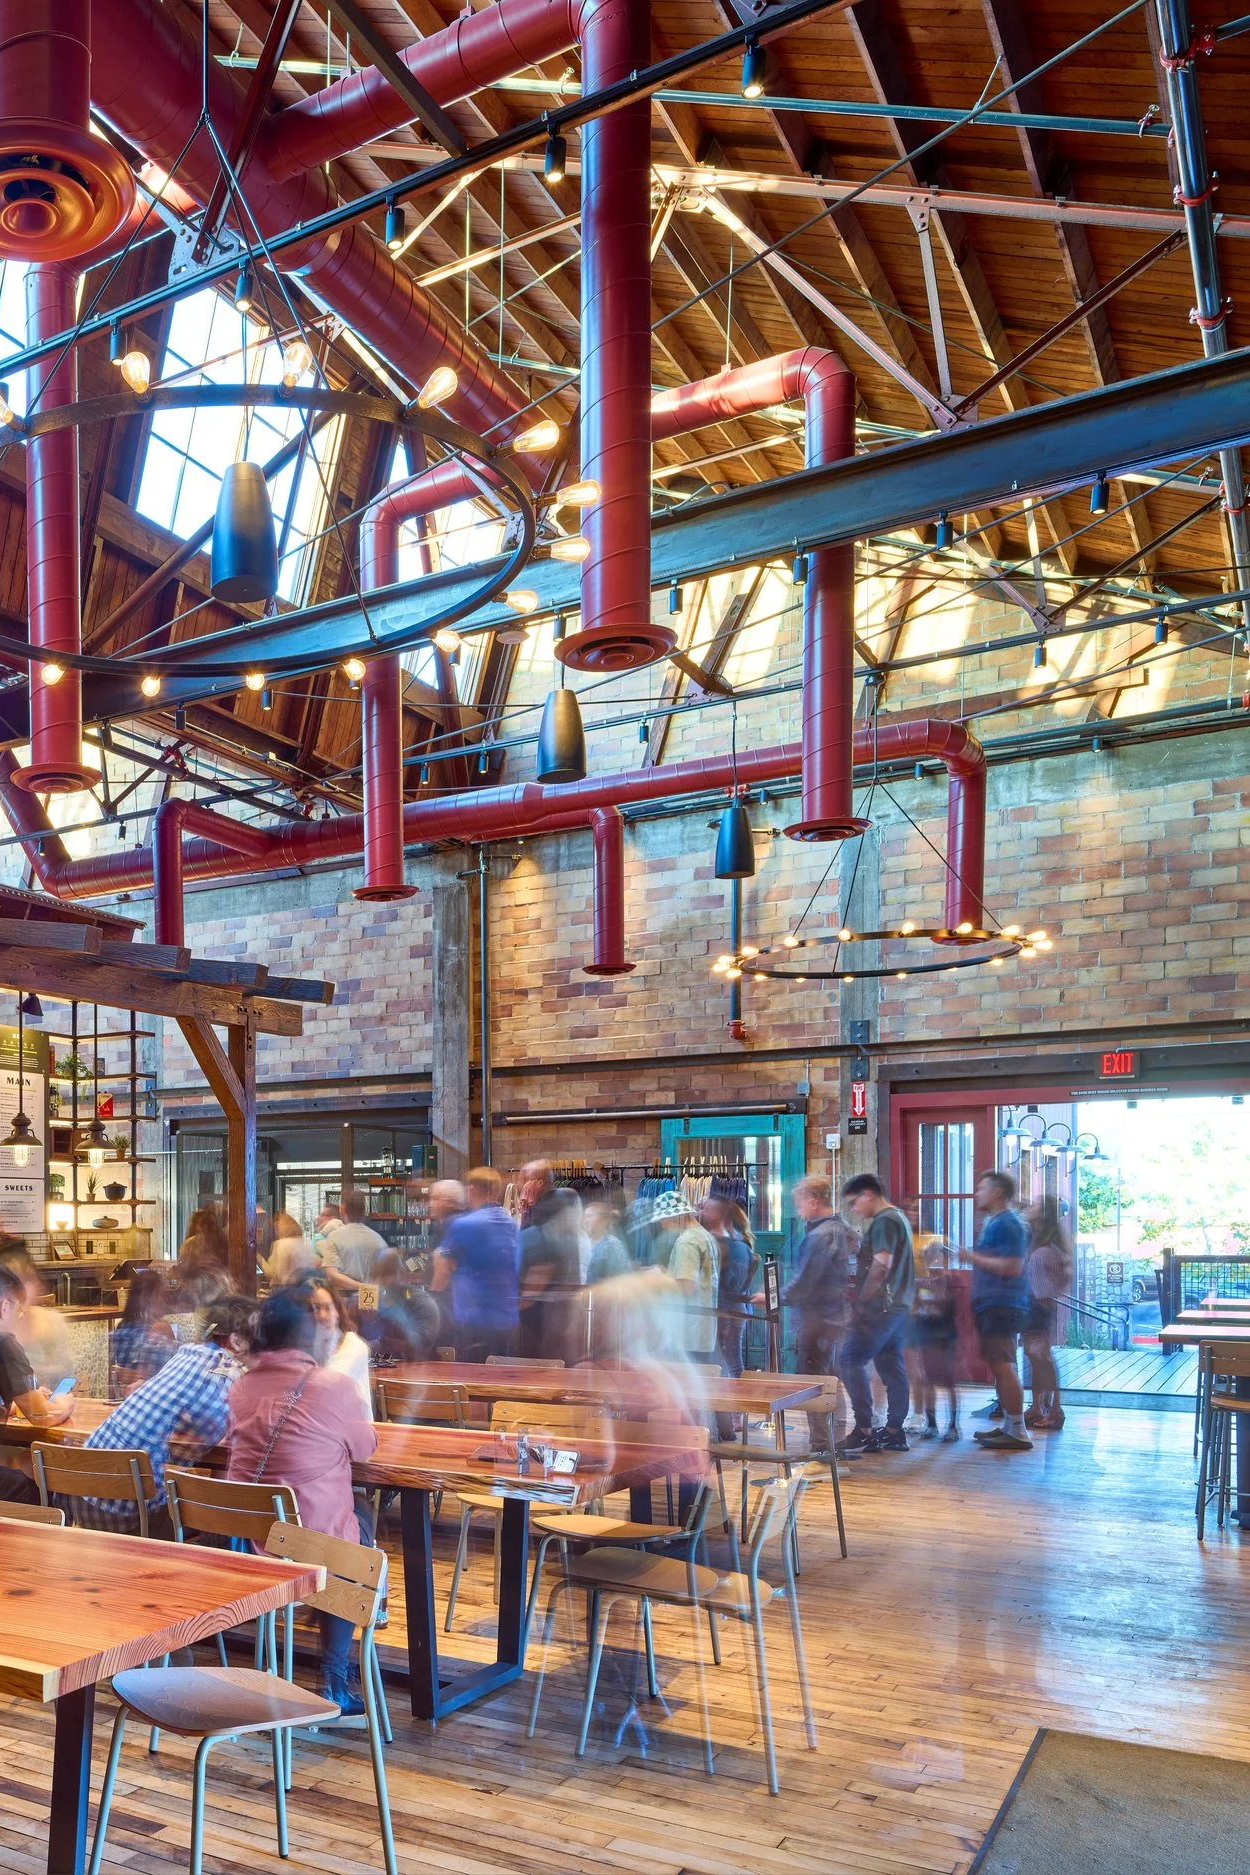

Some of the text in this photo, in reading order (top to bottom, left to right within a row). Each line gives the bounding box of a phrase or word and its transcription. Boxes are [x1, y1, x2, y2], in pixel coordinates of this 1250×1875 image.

[1102, 1052, 1134, 1074] EXIT
[6, 1077, 31, 1087] MAIN
[4, 1184, 34, 1192] SWEETS
[363, 1291, 375, 1304] 25
